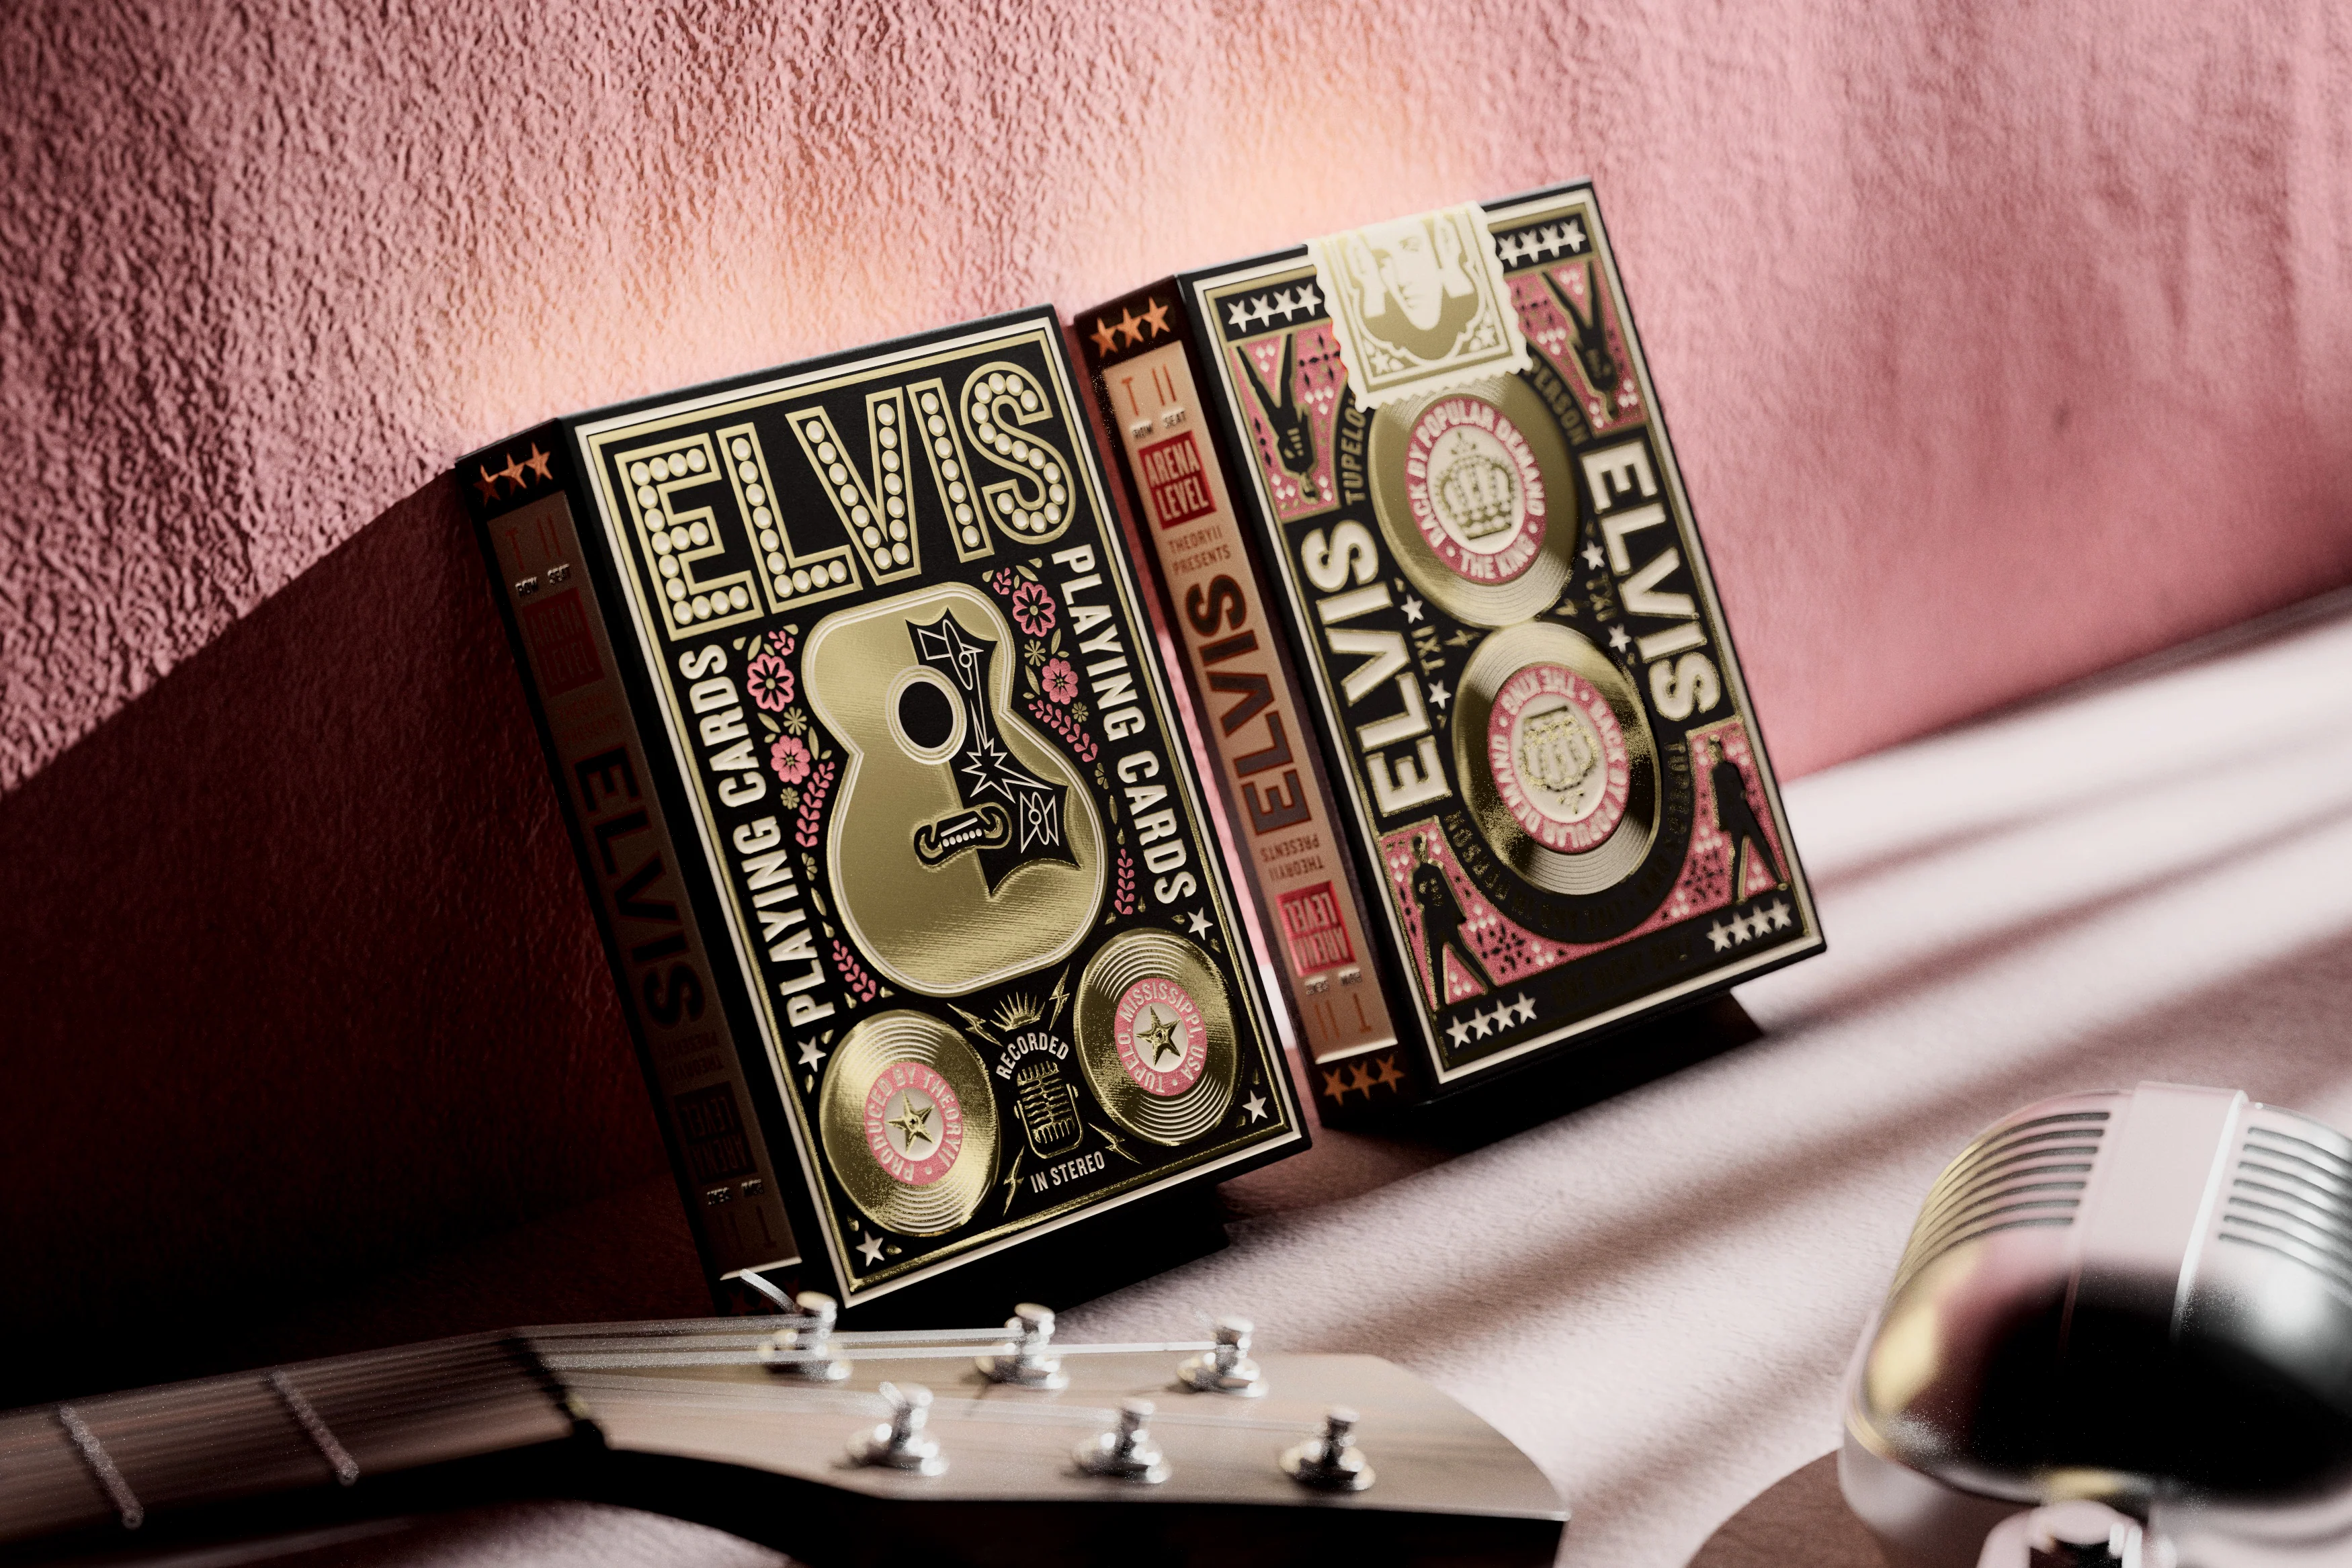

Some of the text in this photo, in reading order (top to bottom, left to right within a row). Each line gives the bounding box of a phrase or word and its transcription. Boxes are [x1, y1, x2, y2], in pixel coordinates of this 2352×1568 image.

[1122, 377, 1139, 416] T
[1162, 408, 1187, 429] SEAT
[1144, 440, 1201, 488] ARENA
[1408, 398, 1546, 548] BACK BY POPULAR DEMAND
[614, 361, 1077, 641] ELVIS
[1155, 476, 1210, 522] LEVEL
[1172, 544, 1232, 575] PRESENTS
[1458, 532, 1538, 579] THE KING
[515, 576, 539, 598] ROW
[1579, 437, 1722, 723] ELVIS
[542, 640, 595, 687] LEVEL
[1301, 519, 1453, 817] ELVIS
[1411, 624, 1445, 675] TXI
[1051, 543, 1197, 904] PLAYING CARDS
[1185, 574, 1312, 836] ELVIS
[1490, 734, 1542, 834] DEMAND
[678, 644, 836, 1028] PLAYING CARDS
[1261, 834, 1320, 863] PRESENTS
[571, 743, 706, 1029] ELVIS
[1283, 891, 1337, 932] LEVEL
[1292, 926, 1349, 969] ARENA
[995, 1031, 1069, 1080] RECORDED
[1180, 1045, 1205, 1082] USA
[681, 1095, 735, 1141] LEVEL
[866, 1077, 915, 1182] PRODUCED
[892, 1065, 917, 1087] BY
[1030, 1150, 1106, 1194] IN STEREO
